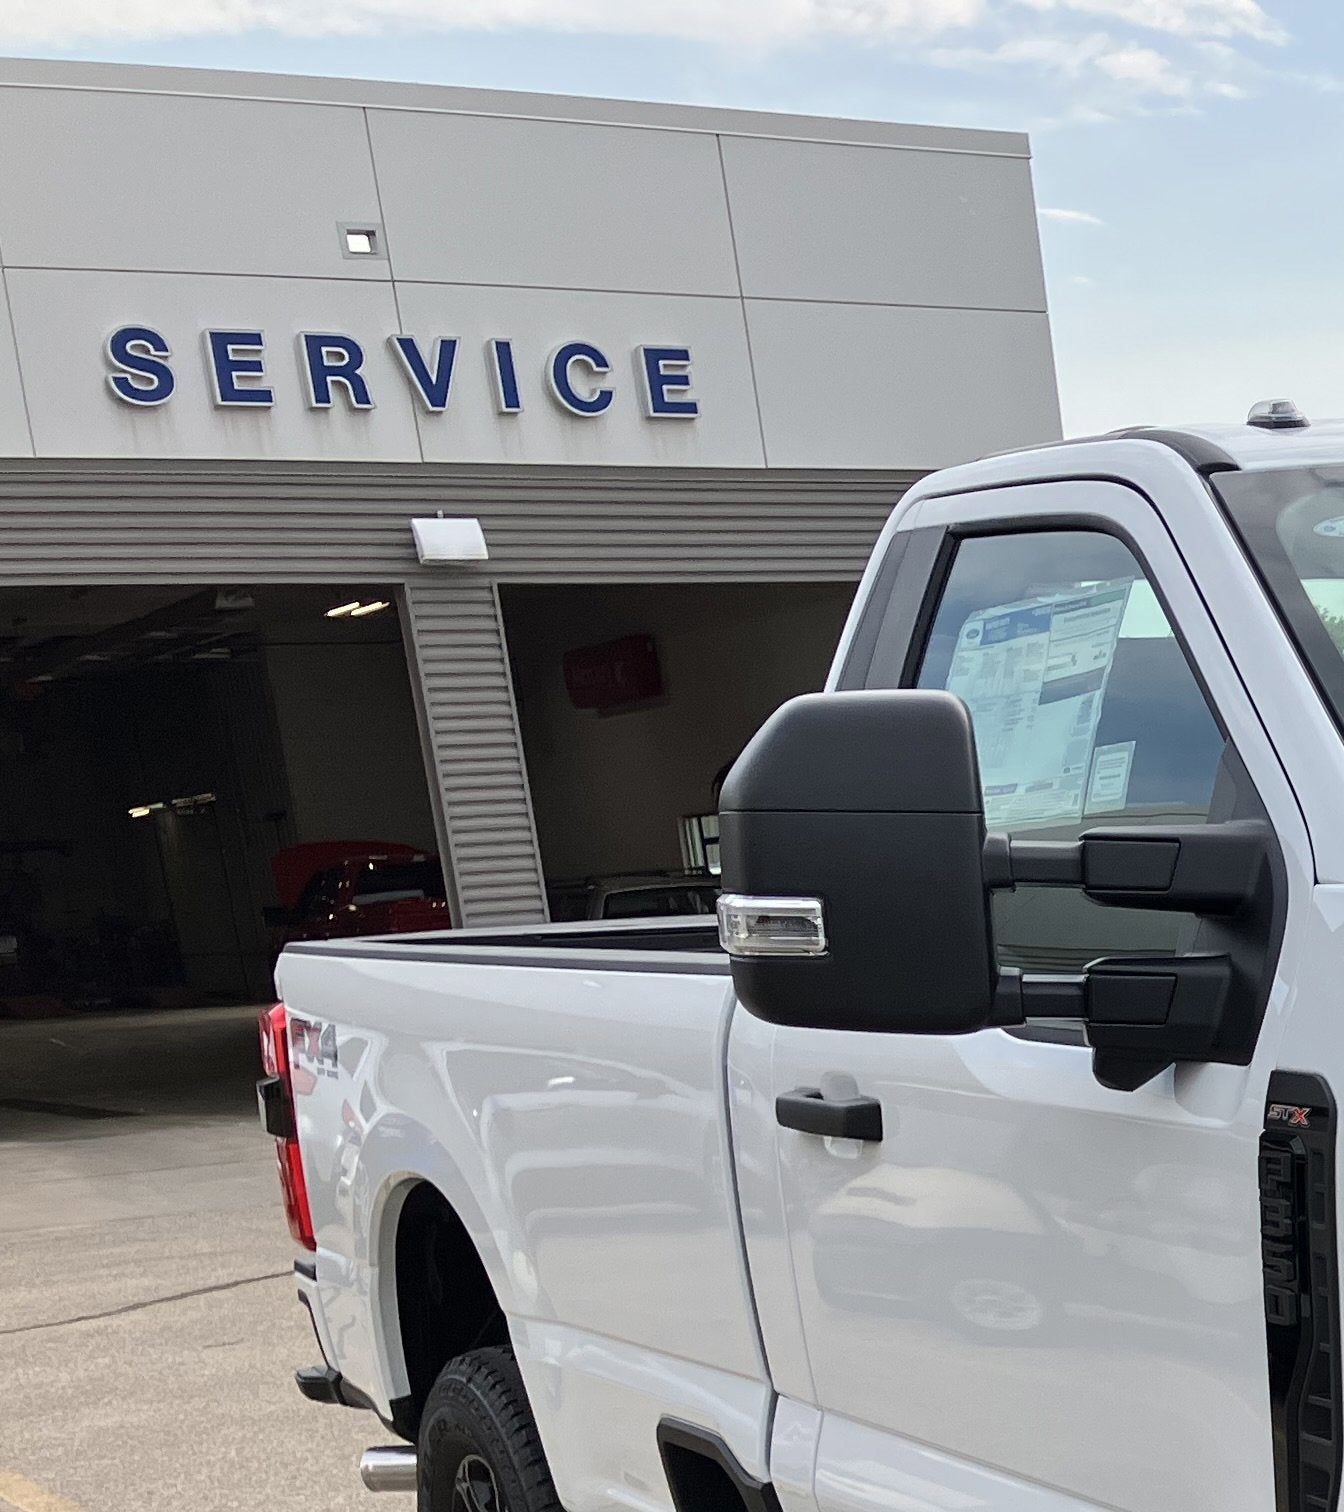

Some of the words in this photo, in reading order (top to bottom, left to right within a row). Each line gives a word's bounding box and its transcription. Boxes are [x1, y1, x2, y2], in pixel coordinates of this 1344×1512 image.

[105, 325, 700, 419] SERVICE
[290, 1016, 339, 1070] FX4
[1267, 1103, 1312, 1129] STX
